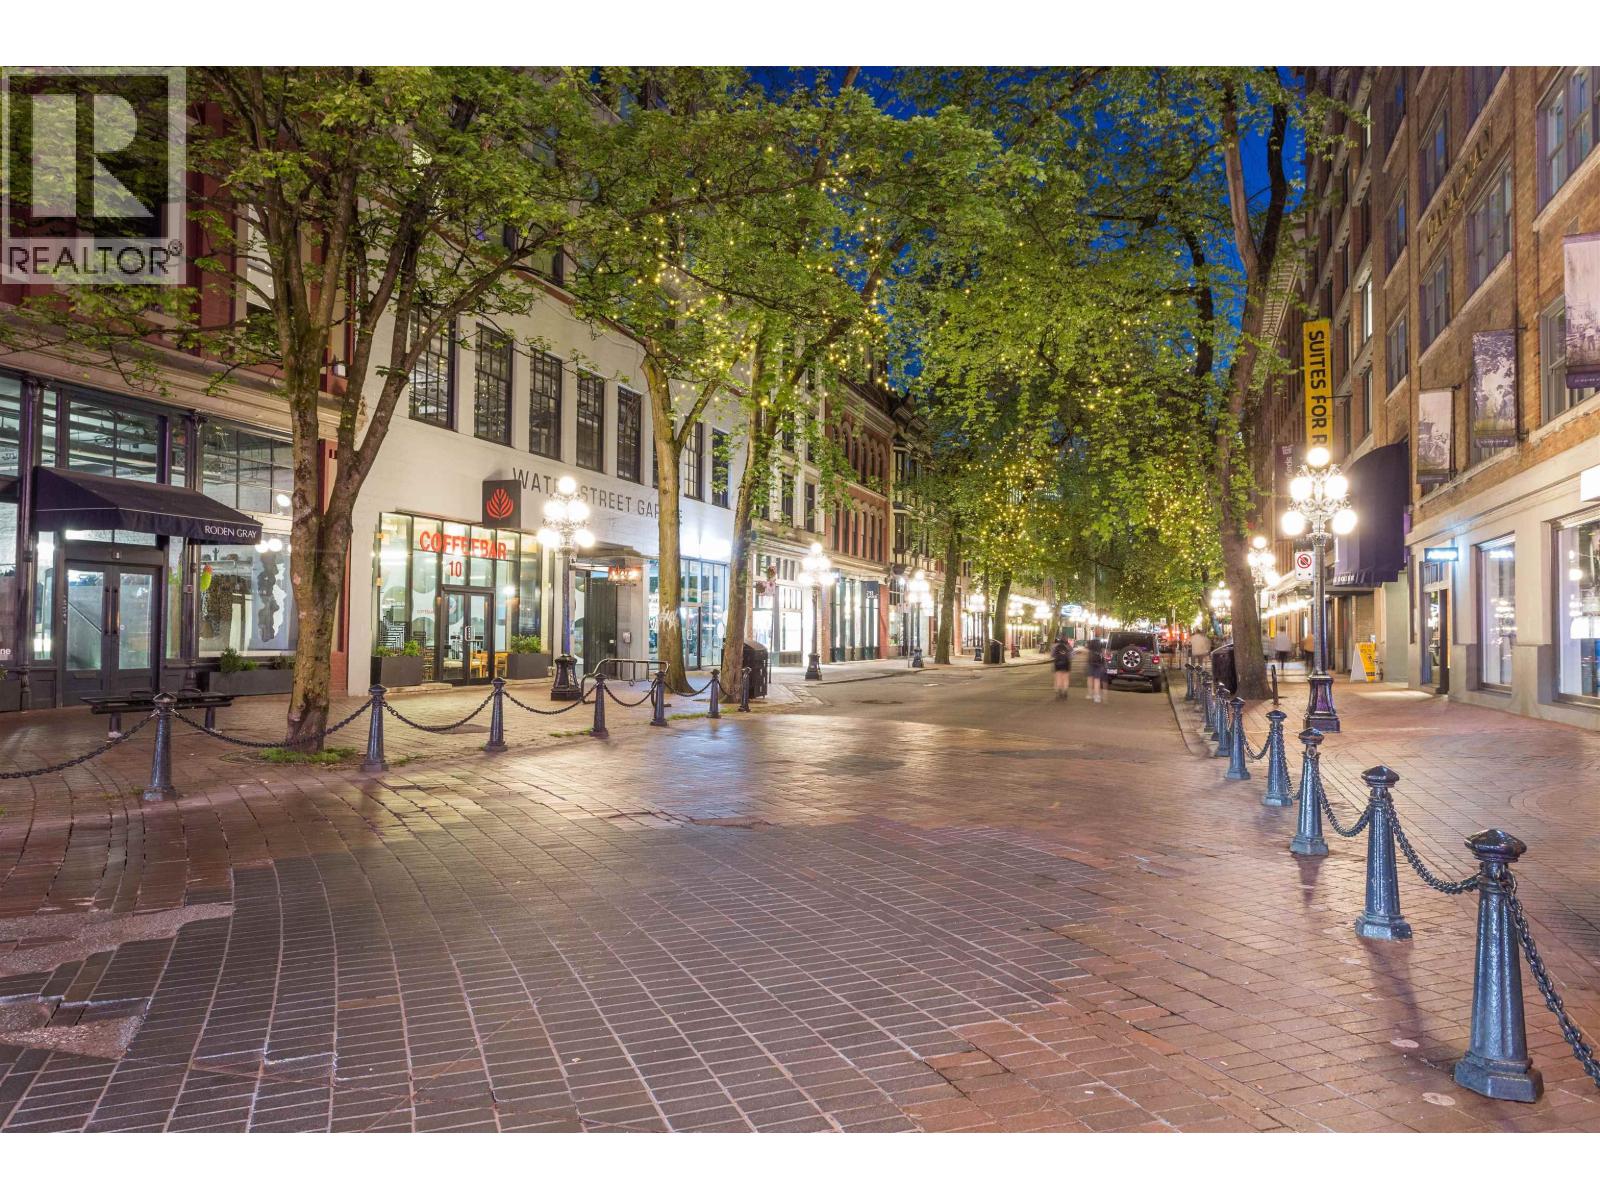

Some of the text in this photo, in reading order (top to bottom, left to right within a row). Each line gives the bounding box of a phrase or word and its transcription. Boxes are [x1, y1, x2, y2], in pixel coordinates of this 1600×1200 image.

[1308, 330, 1326, 390] SUITES
[1311, 395, 1328, 430] FOR
[579, 484, 632, 513] STREET
[204, 525, 257, 539] RODEN GRAY
[419, 530, 507, 560] COFFEEBAR
[449, 560, 463, 578] 10
